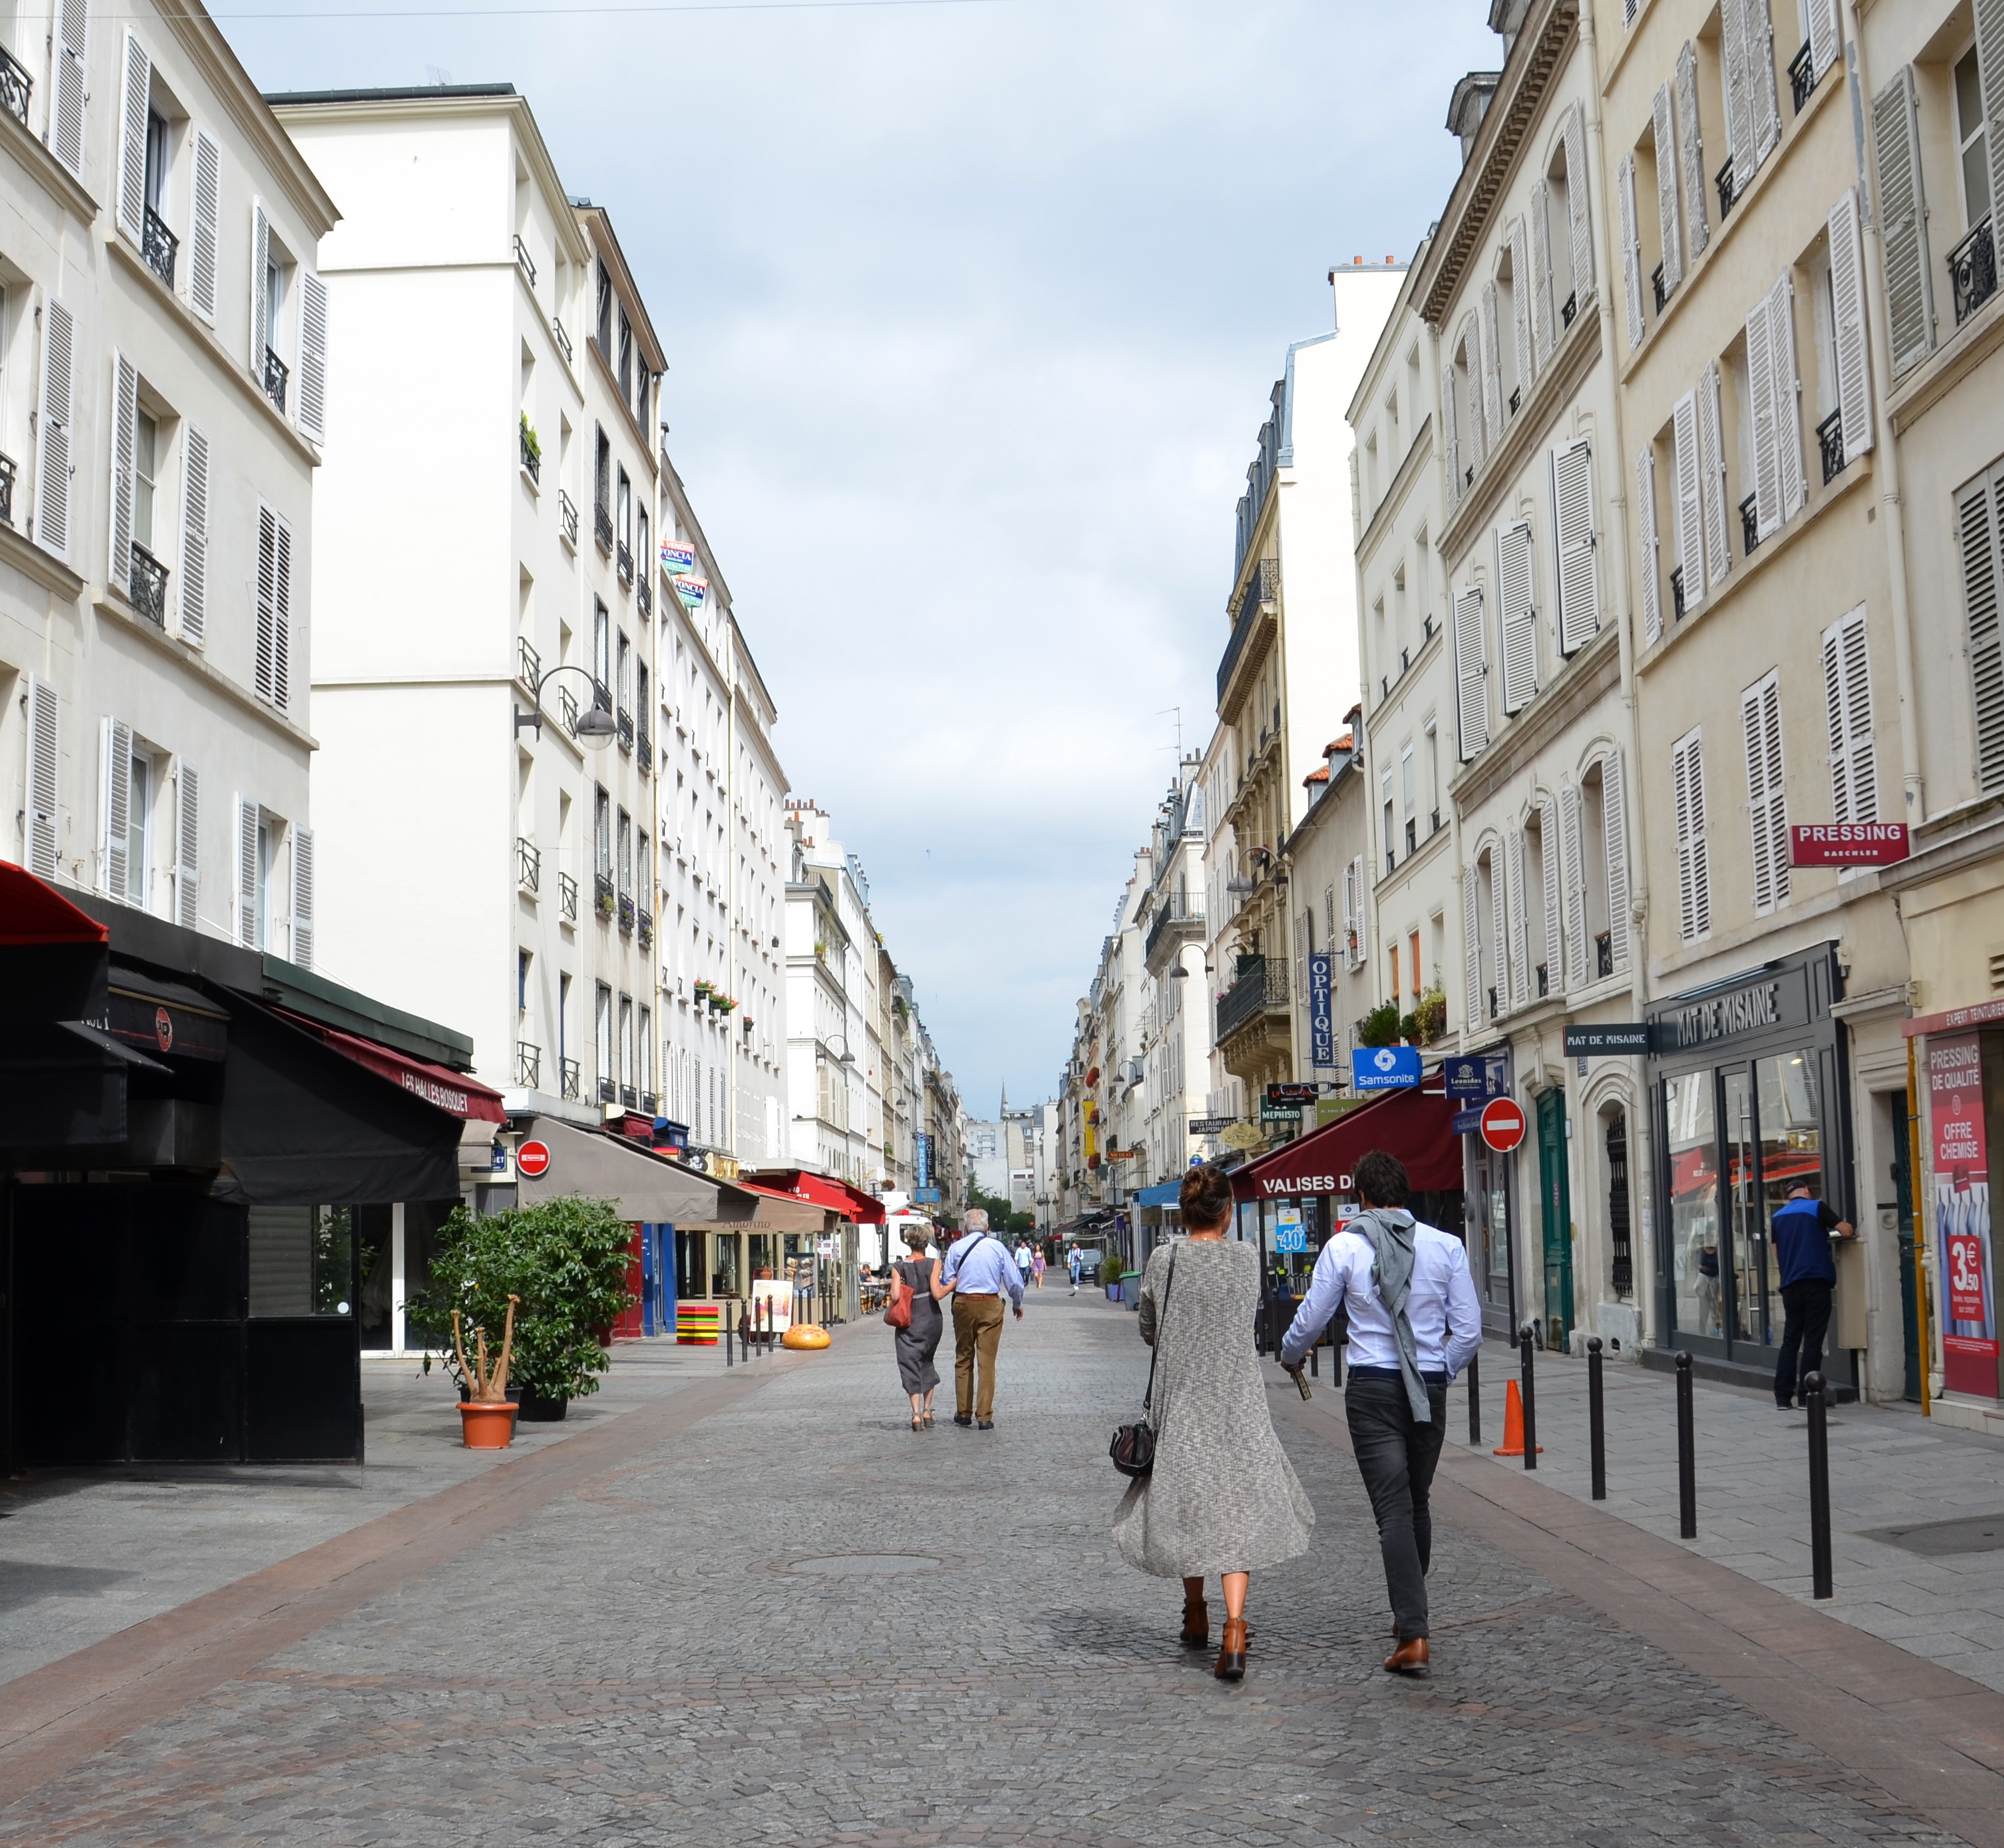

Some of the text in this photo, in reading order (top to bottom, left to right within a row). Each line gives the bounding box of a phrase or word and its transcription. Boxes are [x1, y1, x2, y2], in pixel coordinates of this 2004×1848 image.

[1799, 825, 1901, 841] PRESSING
[1312, 961, 1330, 1060] OPTIQUE
[1677, 983, 1776, 1047] MAT DE MISAINE
[1946, 1010, 1968, 1026] EXPERT
[1567, 1034, 1645, 1045] MAT DE MISAINE
[1931, 1044, 1978, 1070] PRESSING
[1358, 1073, 1414, 1085] Samsonite
[1932, 1065, 1979, 1091] DE QUALITÉ
[402, 1072, 469, 1112] LES HALLES BOSQUET
[1263, 1110, 1300, 1119] MEPHISTO
[1944, 1122, 1972, 1140] OFFRE
[1940, 1141, 1978, 1160] CHEMISE
[1263, 1175, 1355, 1193] VALISES D
